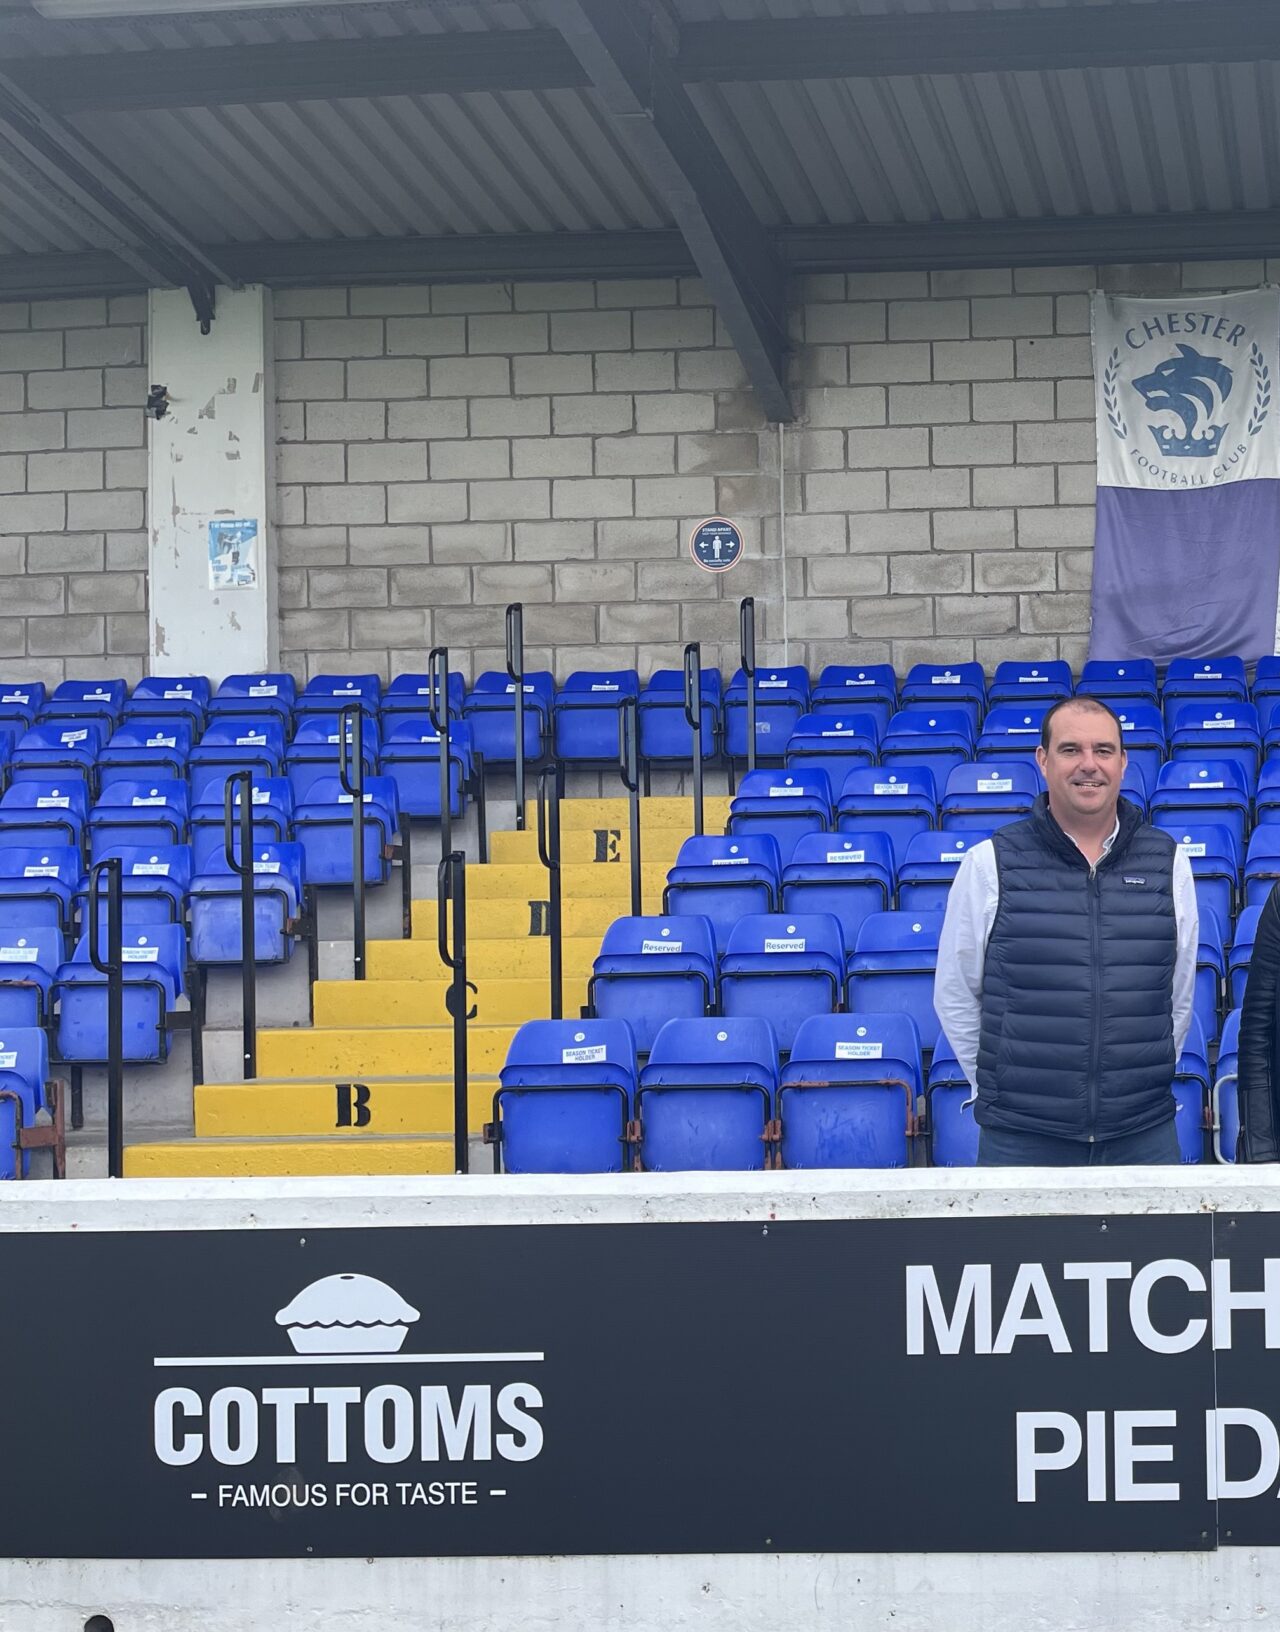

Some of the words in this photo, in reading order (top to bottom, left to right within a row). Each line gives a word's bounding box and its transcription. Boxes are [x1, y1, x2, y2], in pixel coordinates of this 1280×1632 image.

[1125, 312, 1247, 350] CHESTER
[1131, 448, 1208, 487] FOOTBALL
[1213, 443, 1248, 478] CLUB
[593, 830, 621, 862] E
[643, 942, 680, 953] Reserved
[766, 941, 804, 950] Reserved
[446, 981, 478, 1019] C
[336, 1084, 371, 1127] B
[154, 1383, 544, 1466] COTTOMS
[1017, 1410, 1180, 1503] PIE
[218, 1483, 328, 1507] FAMOUS
[335, 1483, 389, 1506] FOR
[396, 1482, 478, 1505] TASTE
